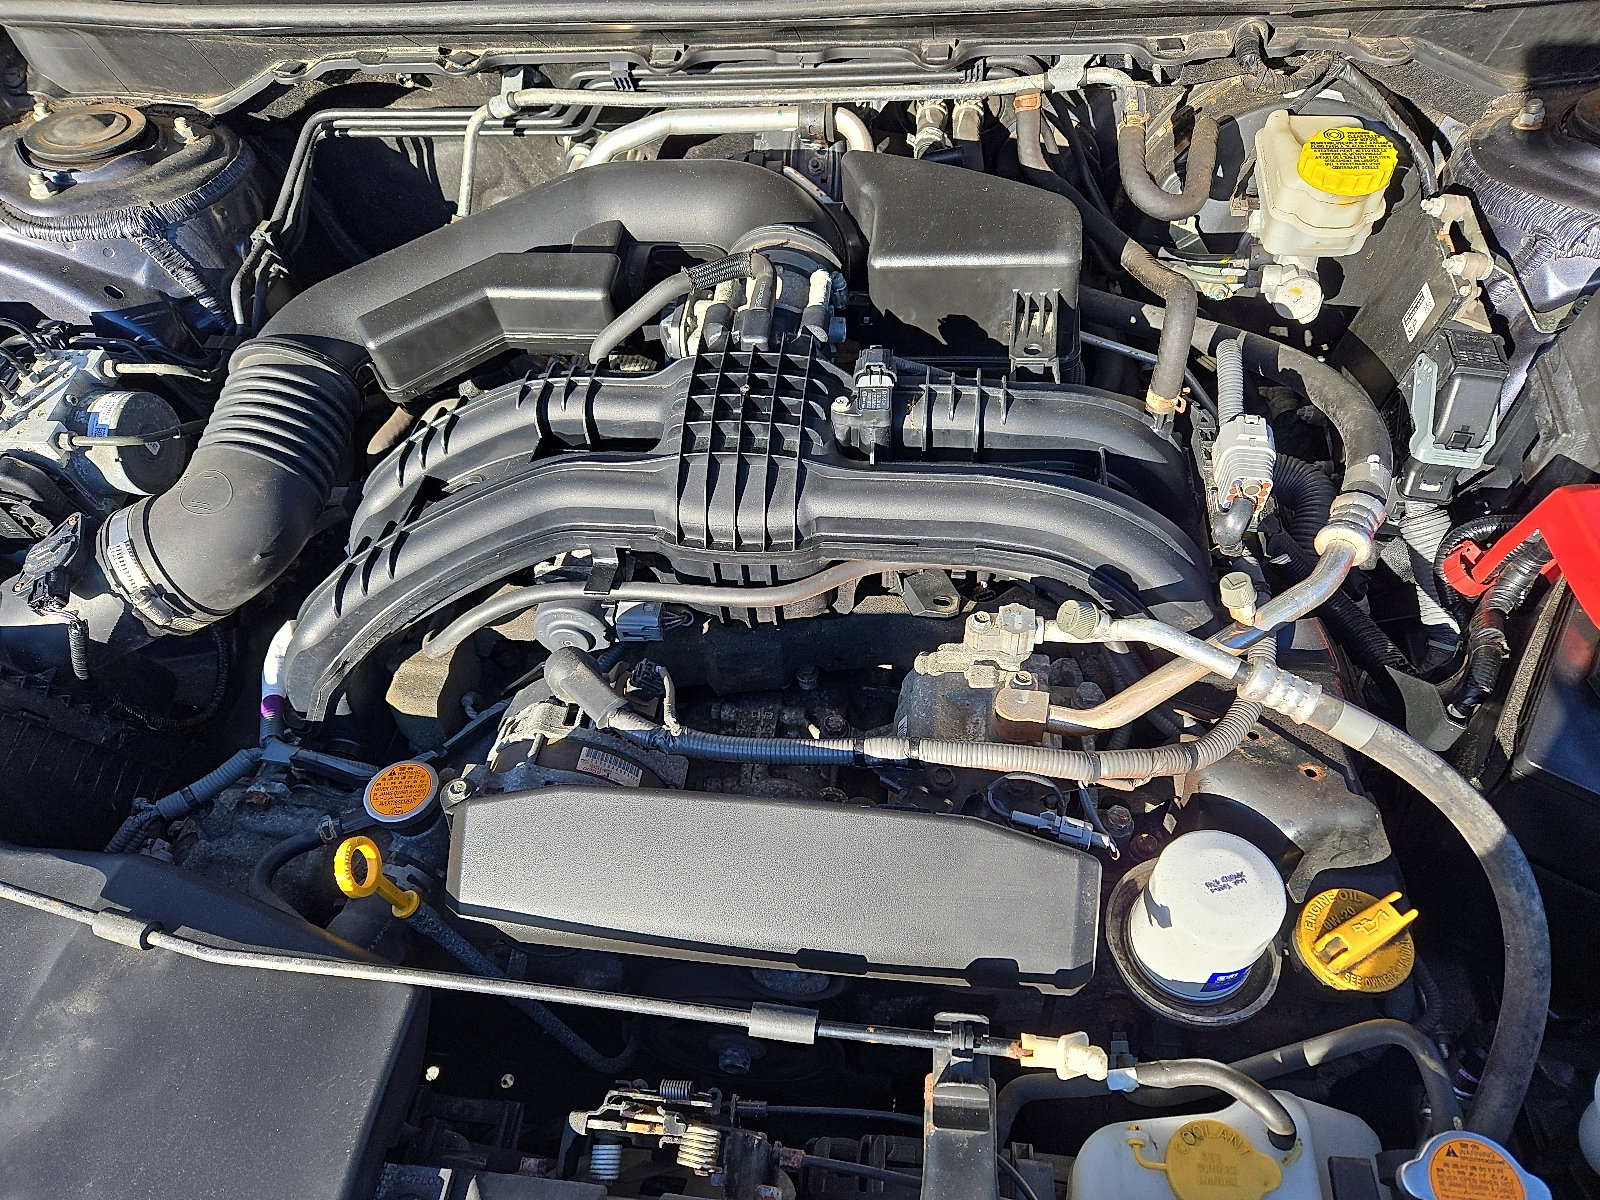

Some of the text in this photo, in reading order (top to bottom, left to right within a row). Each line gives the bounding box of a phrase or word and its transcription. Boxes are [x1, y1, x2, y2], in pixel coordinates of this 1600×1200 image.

[1304, 890, 1362, 931] ENGINE OIL
[1323, 905, 1357, 931] 0W-20
[1344, 939, 1412, 988] SEE OWNER'S MANUAL
[1174, 1122, 1251, 1157] COOLANT
